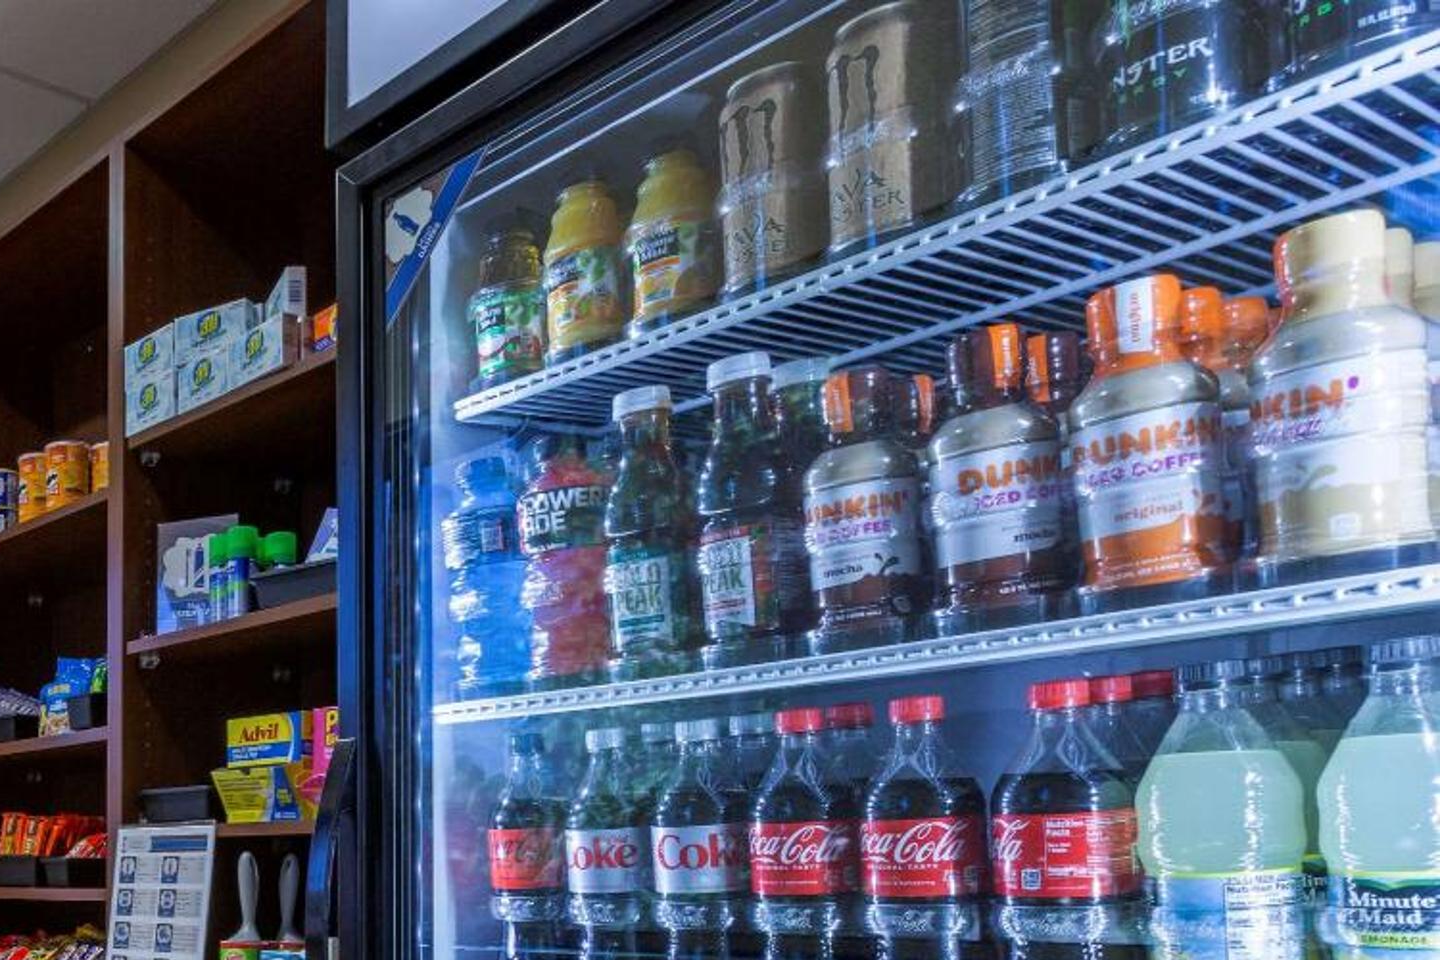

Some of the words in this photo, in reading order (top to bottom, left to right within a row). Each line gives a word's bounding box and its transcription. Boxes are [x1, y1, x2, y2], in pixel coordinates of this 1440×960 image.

[238, 723, 279, 743] Advil
[564, 836, 640, 870] oke
[1348, 890, 1437, 909] Minute
[1359, 908, 1423, 925] Maid
[1358, 933, 1428, 944] EMONADE
